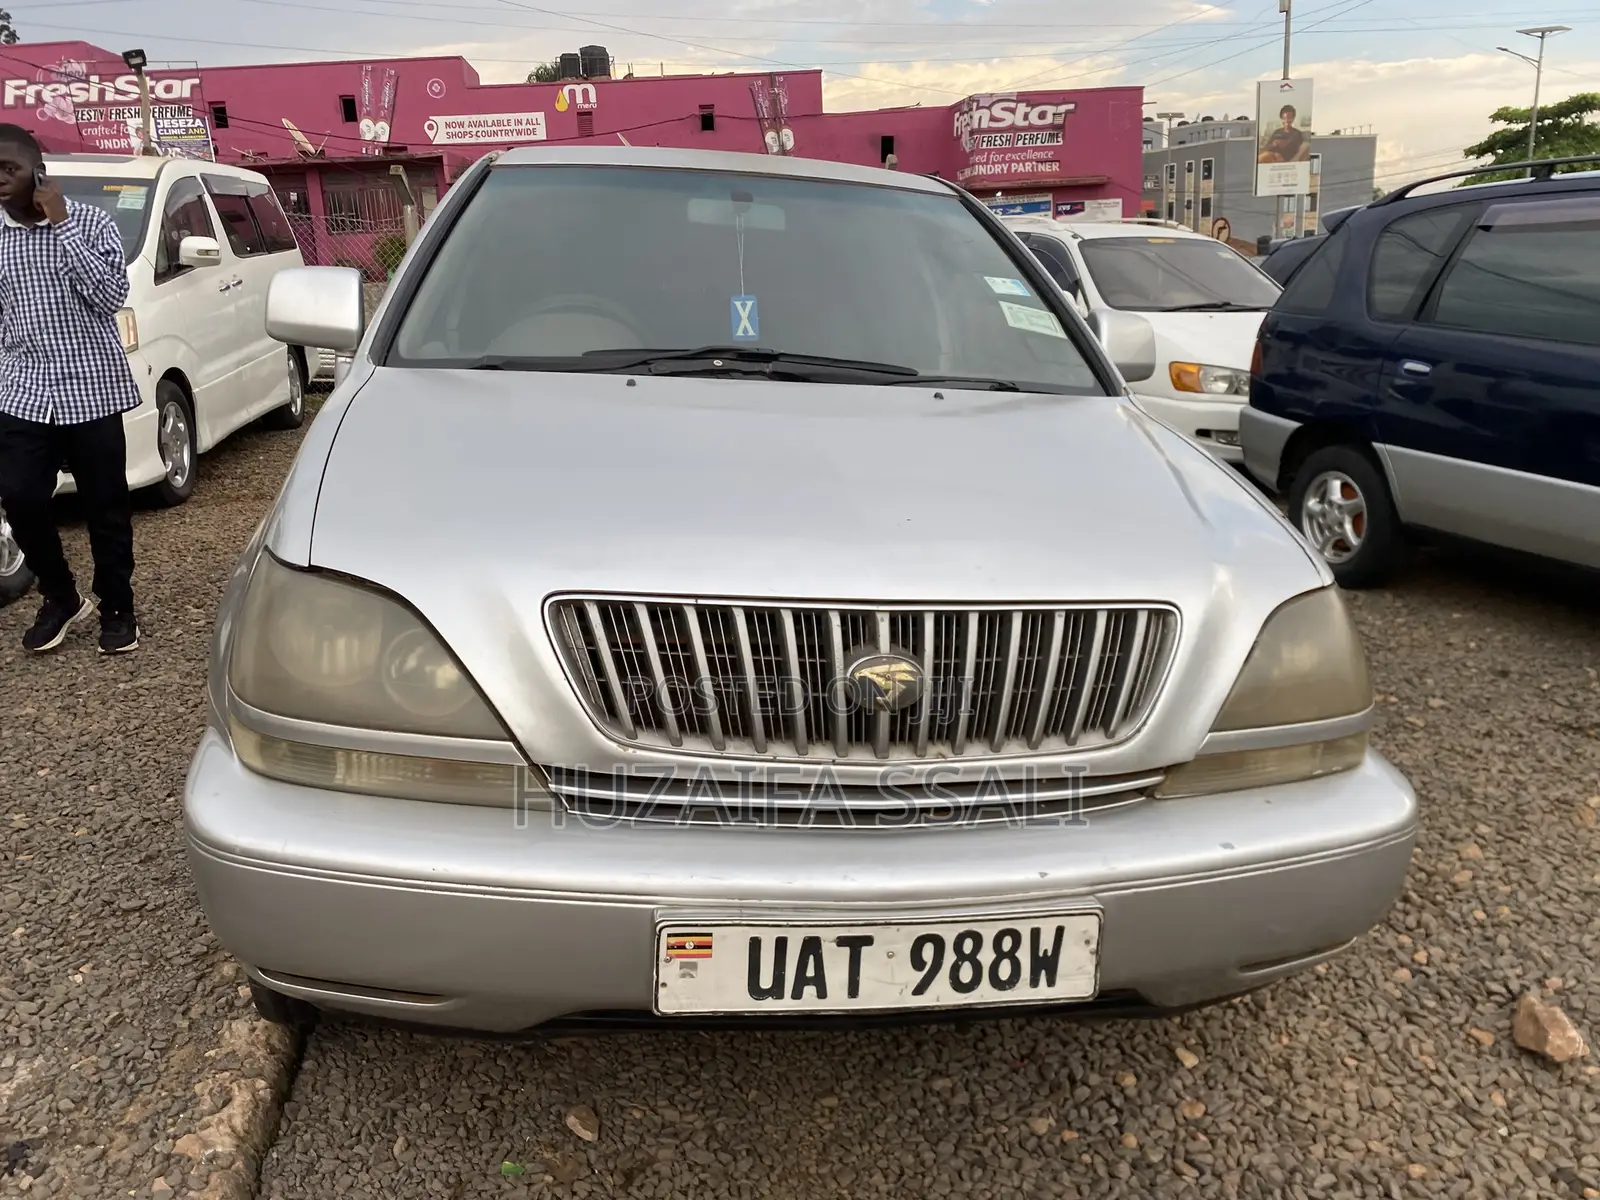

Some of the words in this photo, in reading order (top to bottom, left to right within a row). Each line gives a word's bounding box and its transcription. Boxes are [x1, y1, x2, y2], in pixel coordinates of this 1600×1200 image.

[75, 108, 105, 121] ZESTY
[109, 107, 141, 120] FRESH
[149, 105, 192, 119] ERFUME
[157, 119, 204, 128] JESEZA
[445, 121, 465, 129] NOW
[467, 119, 512, 128] AVAILABLE
[514, 118, 523, 126] IN
[525, 117, 541, 126] ALL
[82, 124, 117, 137] crafted
[446, 130, 474, 139] SHOPS
[476, 127, 537, 138] COUNTRYWIDE
[981, 134, 1012, 147] FRESH
[1016, 131, 1062, 144] PERFUME
[990, 151, 1004, 164] for
[1005, 149, 1054, 161] excellence
[1011, 161, 1060, 173] PARTNER
[732, 300, 756, 336] X
[747, 935, 875, 1001] UAT
[910, 925, 1066, 997] 988W
